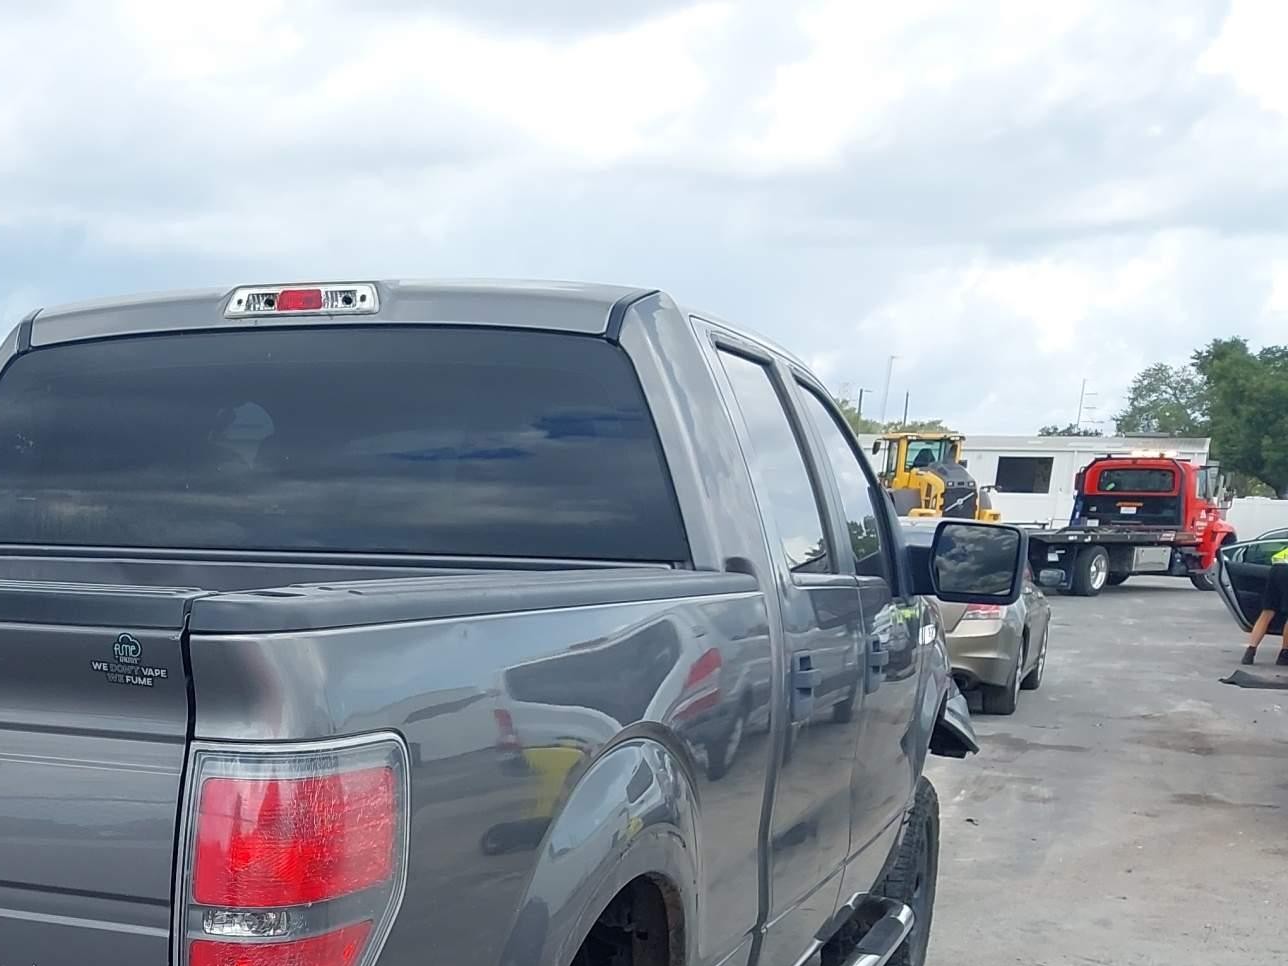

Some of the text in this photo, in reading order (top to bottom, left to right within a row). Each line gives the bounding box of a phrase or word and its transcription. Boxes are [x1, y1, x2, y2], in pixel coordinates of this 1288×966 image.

[92, 661, 108, 671] WE
[141, 667, 167, 678] VAPE
[125, 675, 153, 686] FUME
